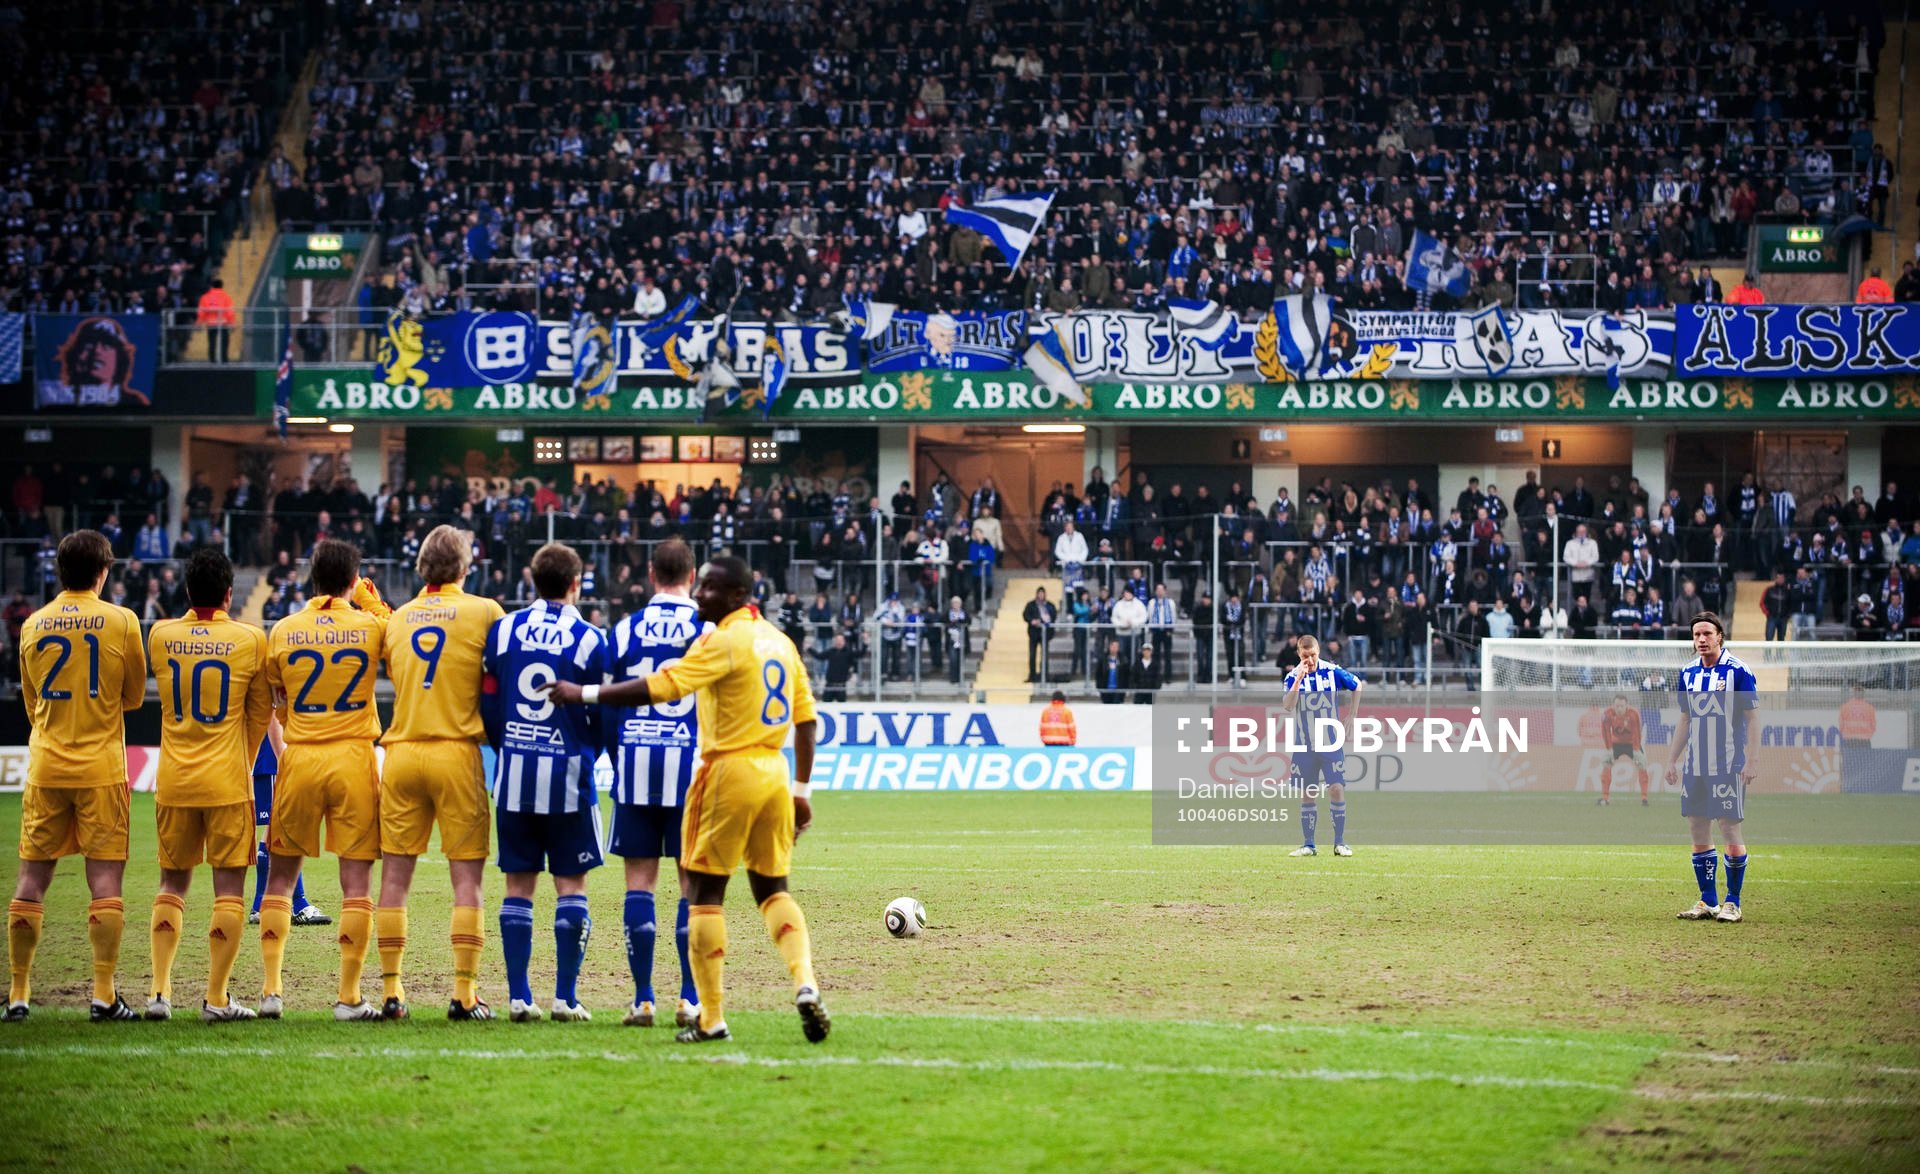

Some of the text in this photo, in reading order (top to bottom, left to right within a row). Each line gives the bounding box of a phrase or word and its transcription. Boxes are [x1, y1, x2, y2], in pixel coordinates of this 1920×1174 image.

[1359, 314, 1424, 326] SYMPATI
[1683, 304, 1920, 373] ÄLSK
[316, 378, 421, 410] ÅBRO
[953, 378, 1058, 409] ÅBRO
[62, 604, 79, 612] ICA
[316, 616, 335, 625] ICA
[645, 621, 685, 638] KIA
[191, 627, 209, 636] ICA
[287, 629, 368, 646] HELLQUIST
[525, 625, 564, 646] KIA
[164, 640, 236, 657] YOUSSEF
[411, 626, 447, 690] 9
[36, 633, 99, 700] 21
[168, 658, 230, 724] 10
[288, 648, 369, 713] 22
[516, 662, 557, 721] 9
[761, 659, 790, 726] 8
[1300, 692, 1333, 712] ICA
[505, 721, 565, 745] SEFA
[623, 719, 691, 740] SEFA
[1712, 783, 1738, 798] ICA
[1721, 800, 1733, 810] 13
[1705, 859, 1715, 881] SKF
